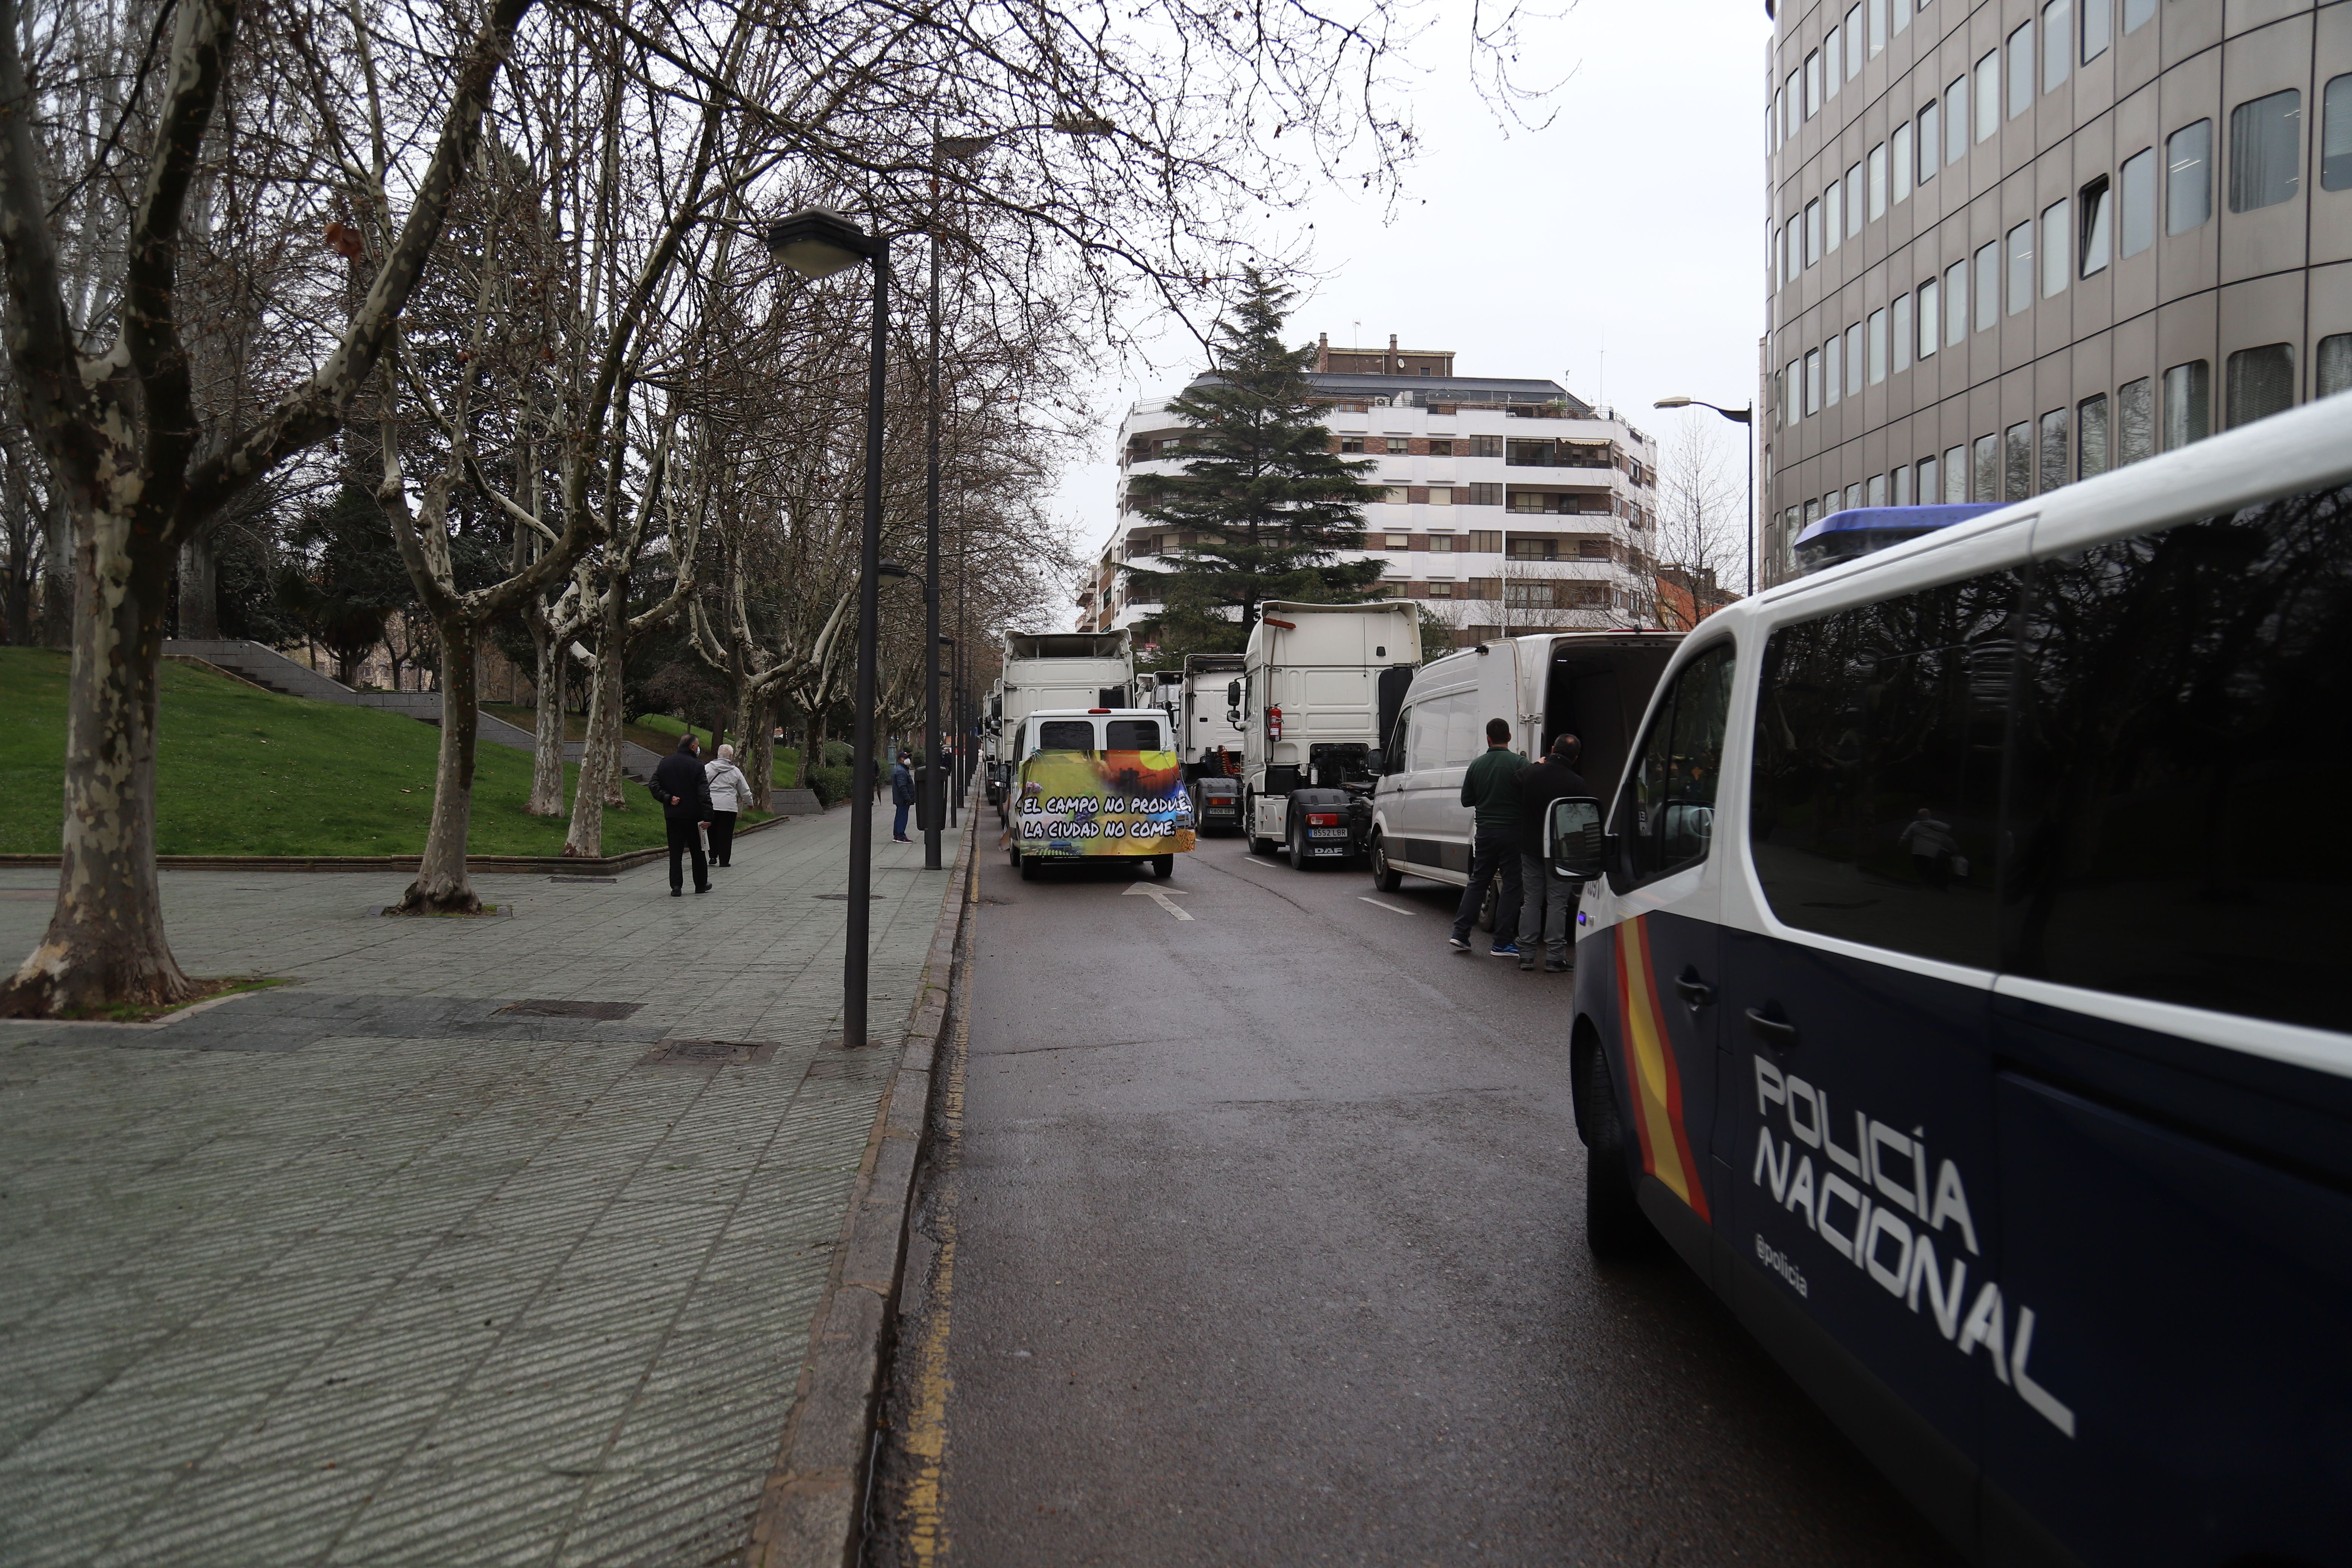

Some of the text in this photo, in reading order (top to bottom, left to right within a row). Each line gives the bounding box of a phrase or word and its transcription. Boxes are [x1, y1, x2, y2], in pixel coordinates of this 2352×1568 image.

[1024, 798, 1041, 813] EL
[1046, 797, 1099, 812] CAMPO
[1105, 798, 1125, 812] NO
[1024, 821, 1175, 838] LA CIUDAD NO COME.
[1755, 1054, 1979, 1255] POLICÍA
[1754, 1126, 2075, 1437] NACIONAL
[1755, 1233, 1808, 1298] @policia
